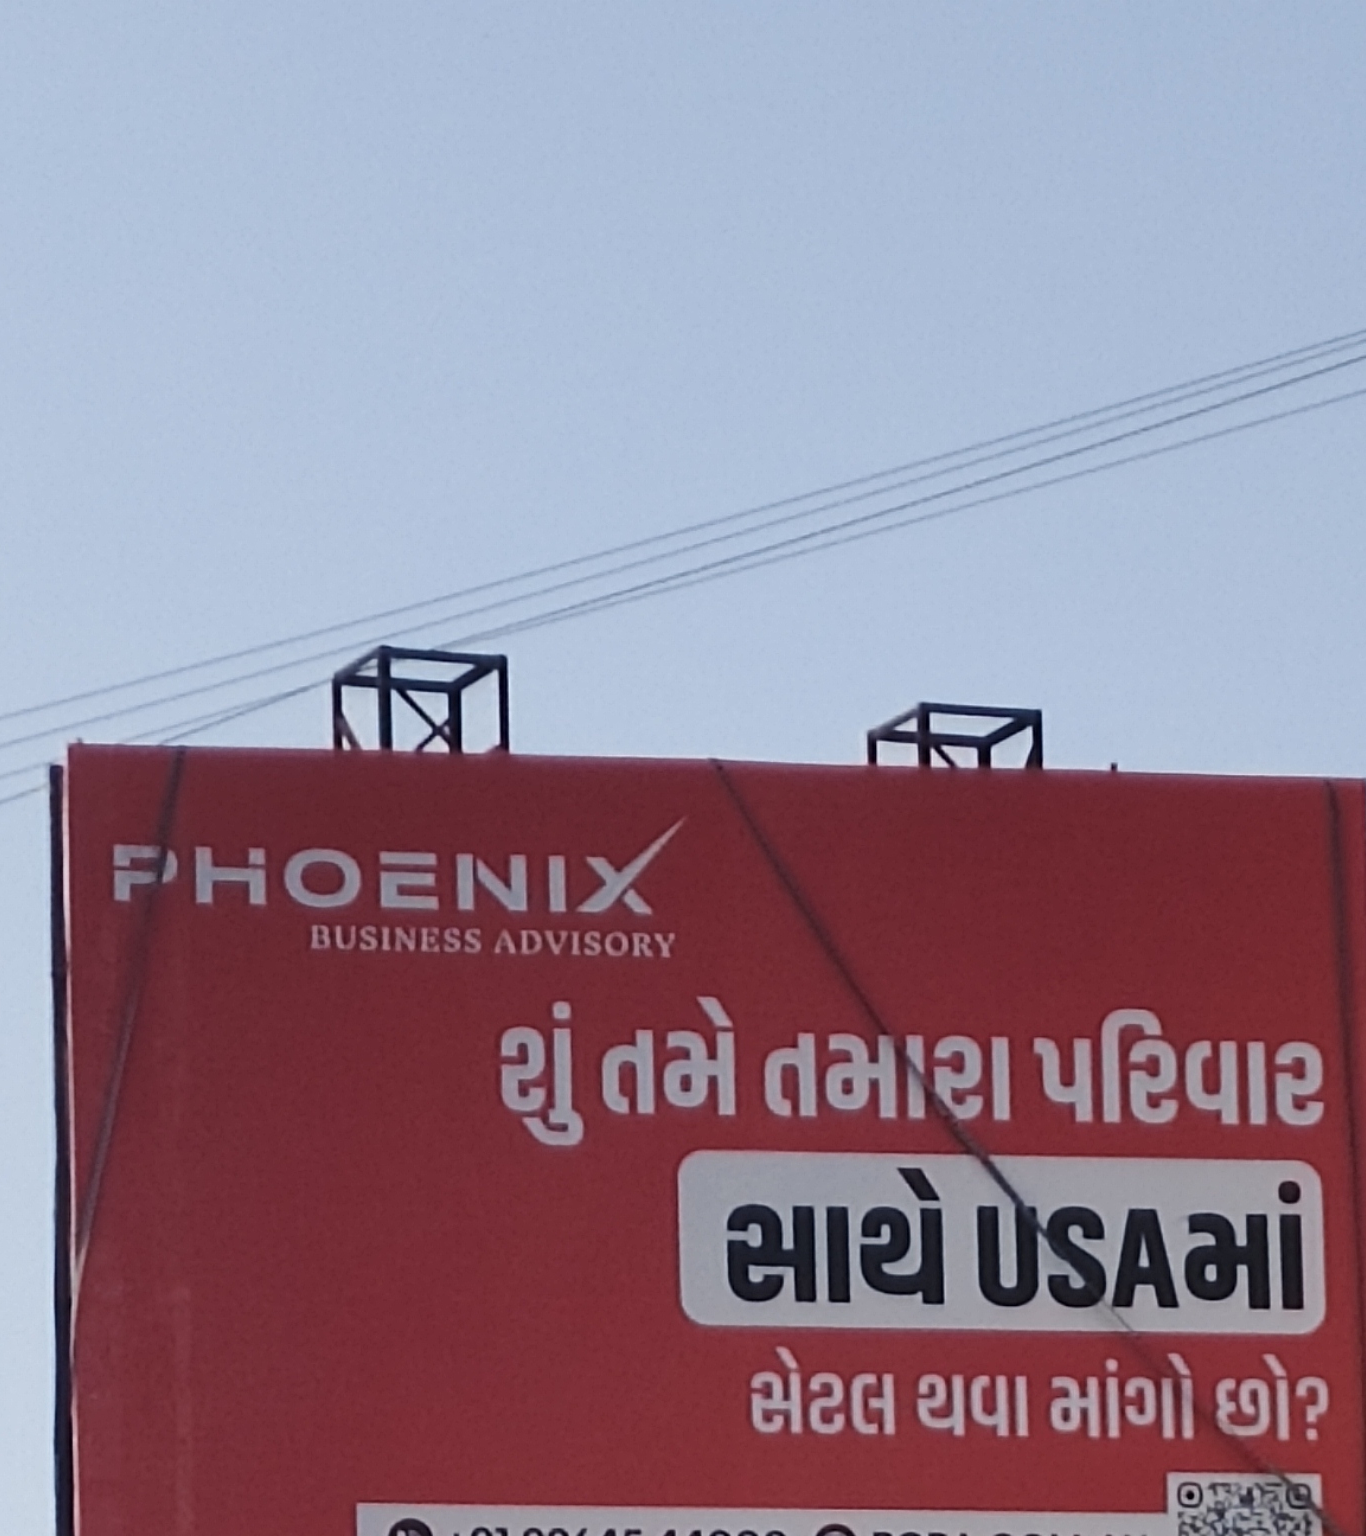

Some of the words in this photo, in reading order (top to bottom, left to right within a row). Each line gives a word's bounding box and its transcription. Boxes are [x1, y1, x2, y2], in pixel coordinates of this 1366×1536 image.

[113, 816, 687, 915] PHOENIX
[310, 924, 483, 953] BUSINESS
[495, 930, 676, 958] ADVISORY
[500, 1001, 584, 1147] શું
[601, 996, 736, 1116] તમે
[764, 1032, 1011, 1121] તમારા
[1033, 1008, 1325, 1127] પરિવાર
[726, 1168, 945, 1305] સાથે
[977, 1181, 1306, 1311] USAમાં
[750, 1346, 896, 1436] સેટલ
[917, 1374, 1029, 1437] થવા
[1050, 1352, 1195, 1440] માંગો
[1215, 1353, 1329, 1441] છો?
